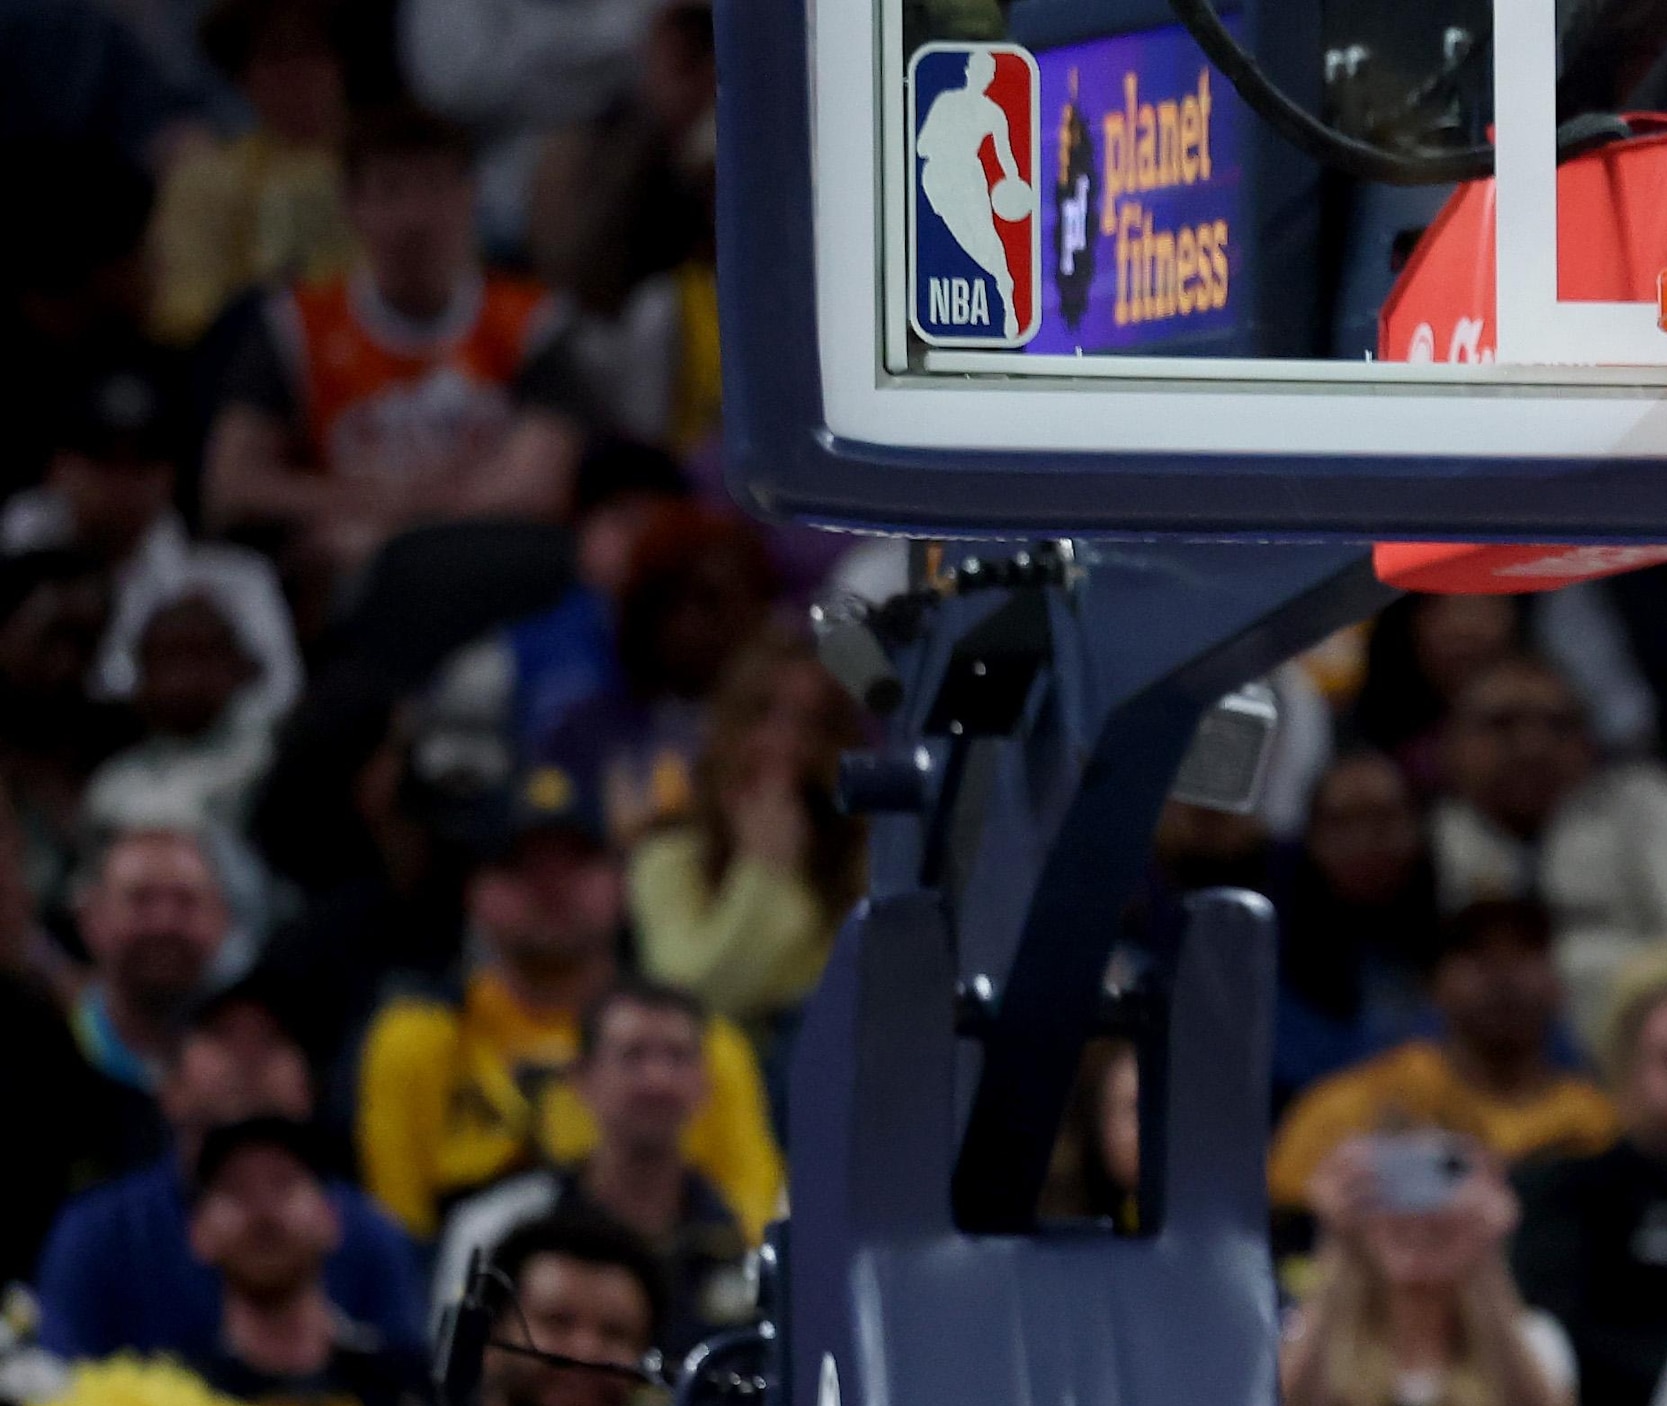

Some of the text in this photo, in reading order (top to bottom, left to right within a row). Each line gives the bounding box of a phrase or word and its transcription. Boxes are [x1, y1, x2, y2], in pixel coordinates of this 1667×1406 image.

[1102, 64, 1211, 236] planet
[929, 276, 991, 326] NBA
[1113, 201, 1229, 327] fitness
